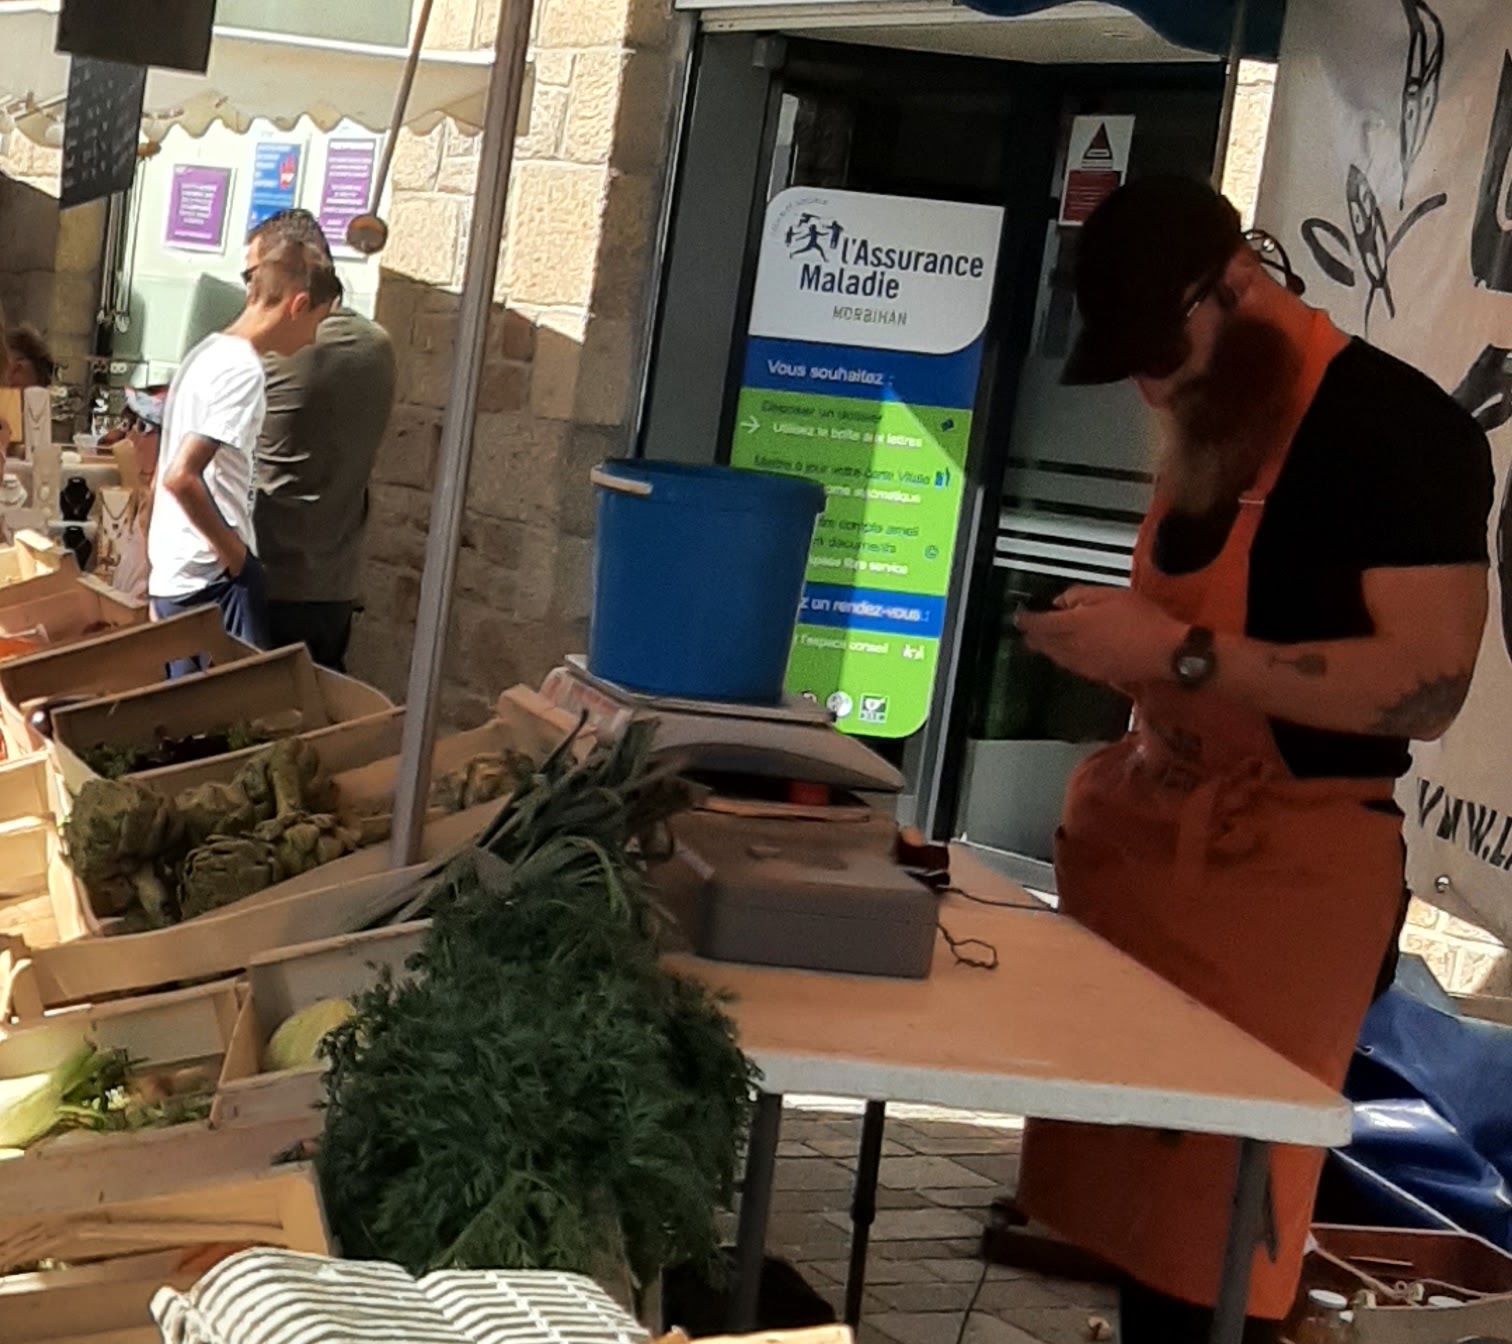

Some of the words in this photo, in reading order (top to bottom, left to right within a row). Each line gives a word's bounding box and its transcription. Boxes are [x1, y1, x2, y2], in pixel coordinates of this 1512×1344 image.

[841, 237, 984, 278] l'Assurance
[799, 263, 900, 300] Maladie
[832, 305, 908, 326] MORBIHAN
[767, 359, 806, 378] Vous
[809, 365, 884, 386] souhaitez
[810, 599, 830, 610] un
[832, 599, 921, 622] rendez-vous
